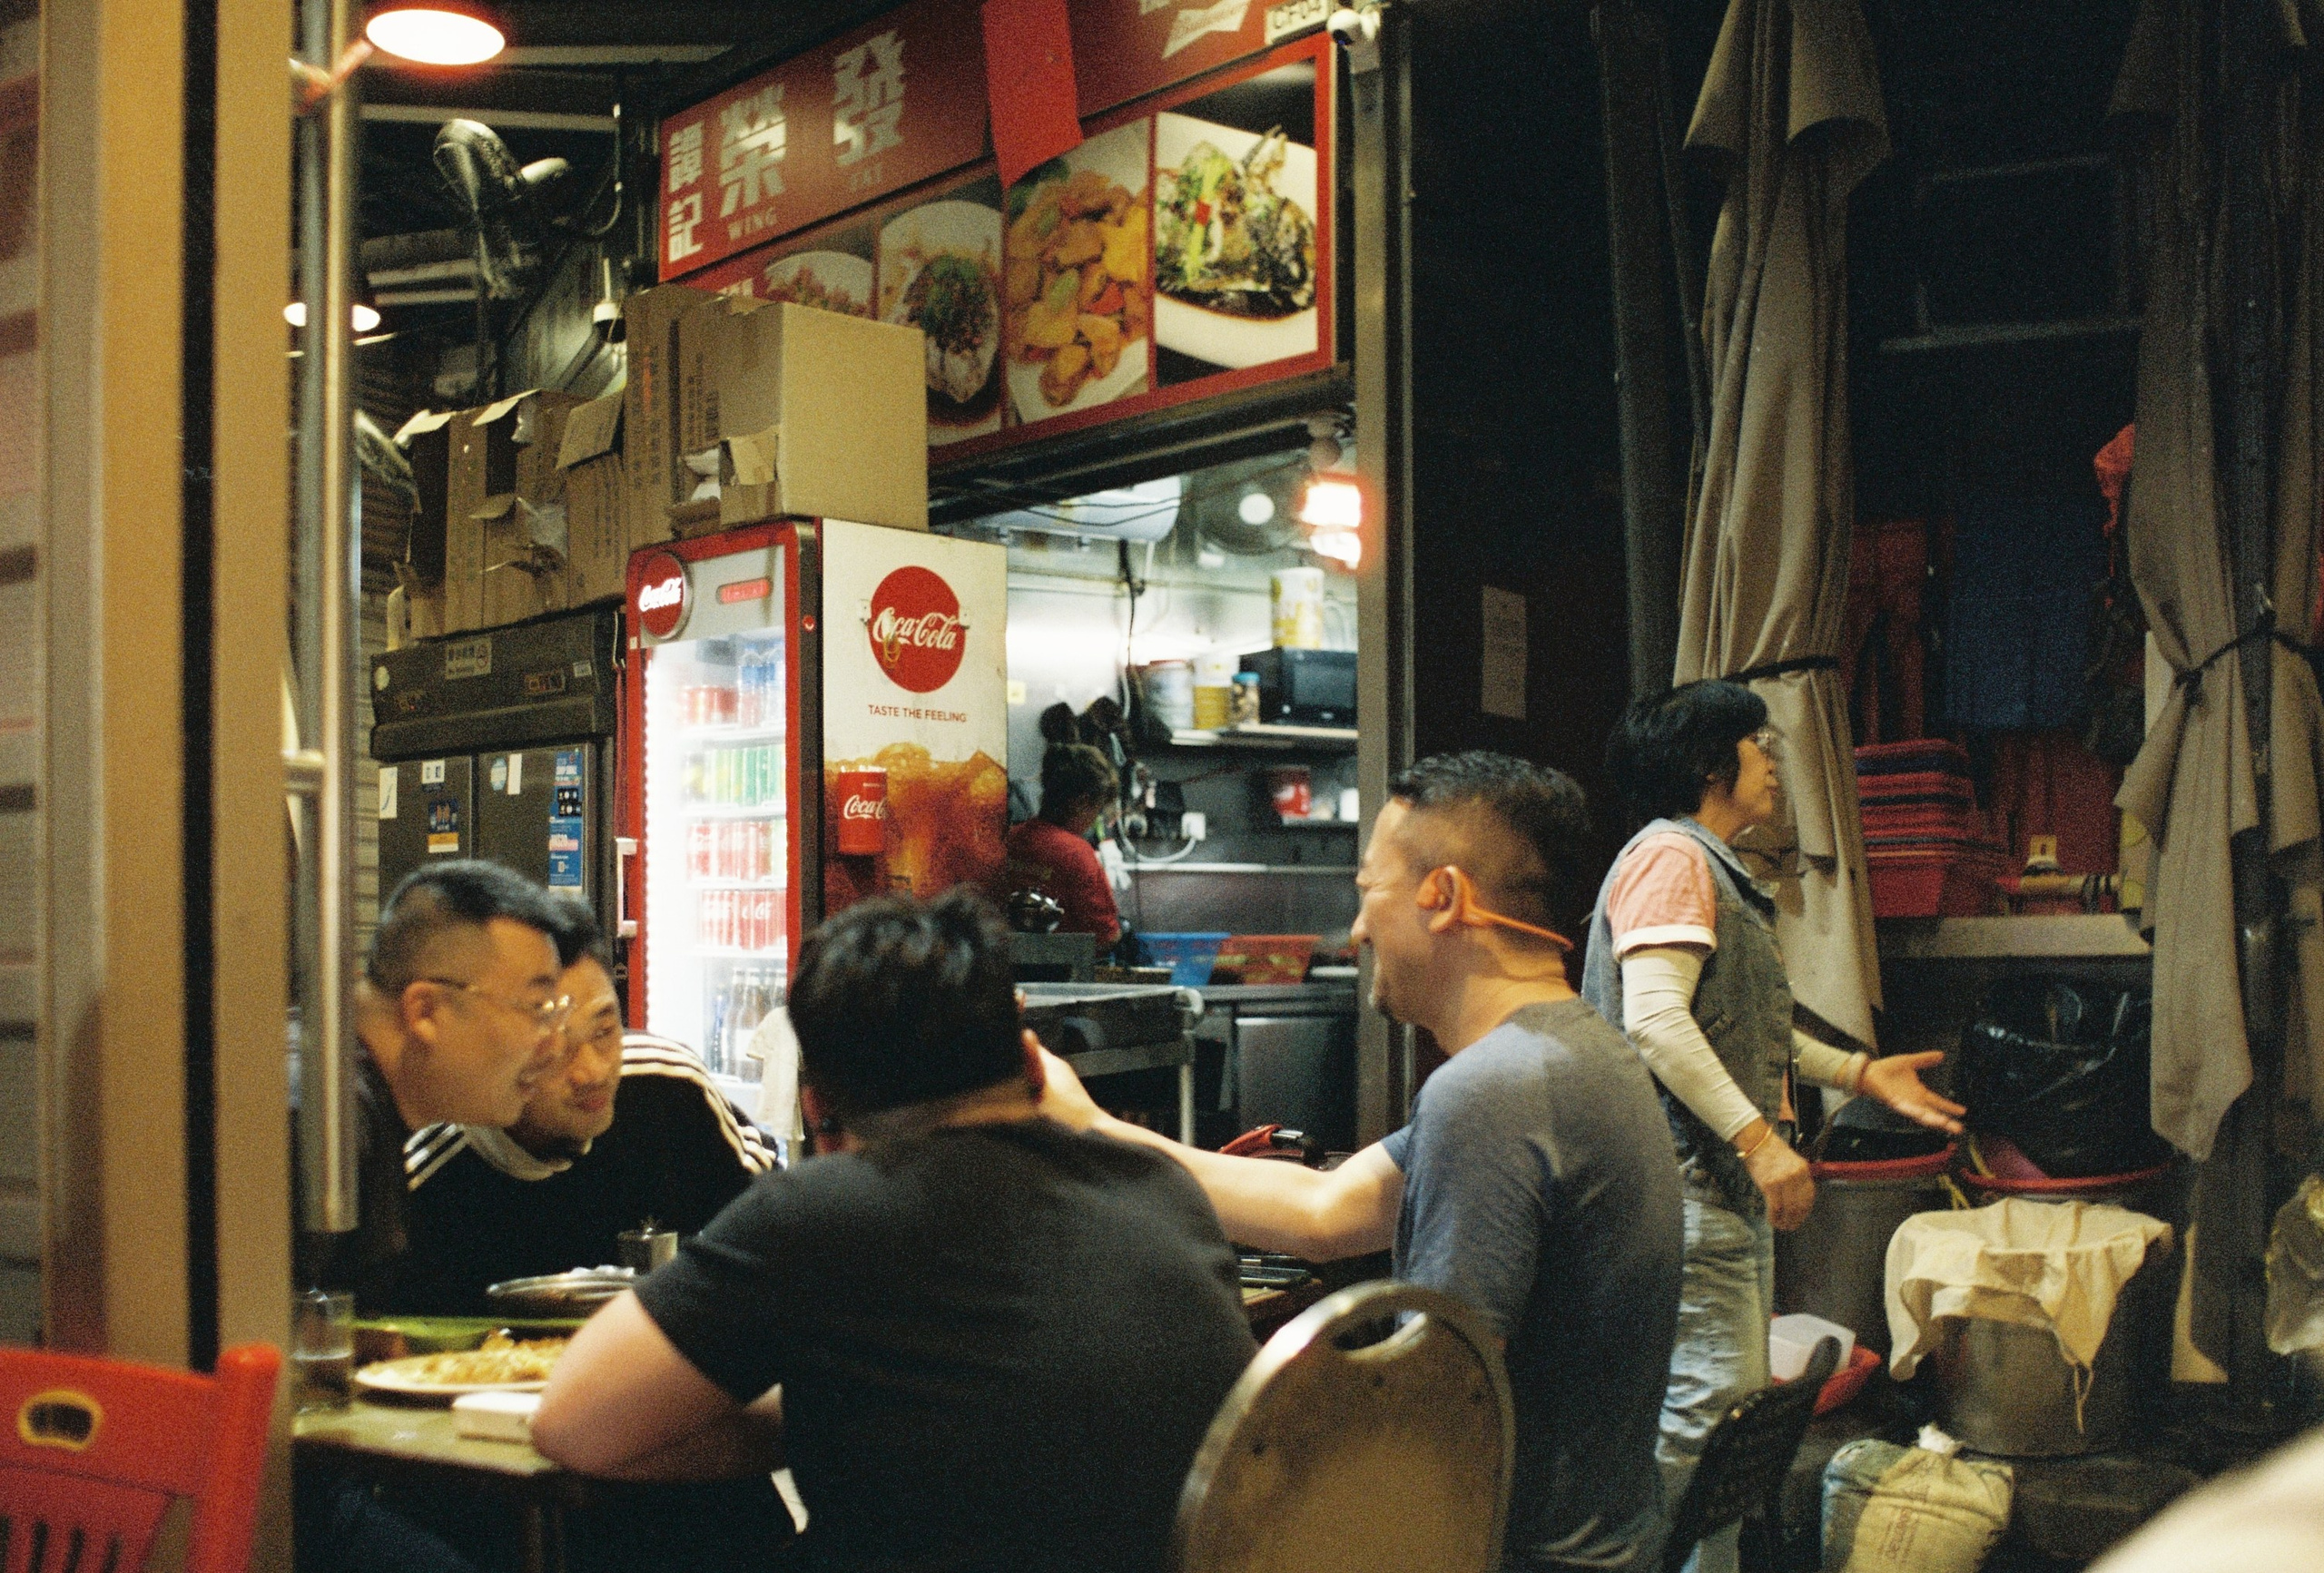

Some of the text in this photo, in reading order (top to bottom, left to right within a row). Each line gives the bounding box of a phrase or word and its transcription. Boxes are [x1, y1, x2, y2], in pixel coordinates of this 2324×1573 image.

[727, 205, 779, 241] WING
[868, 703, 968, 723] TASTE THE FEELING
